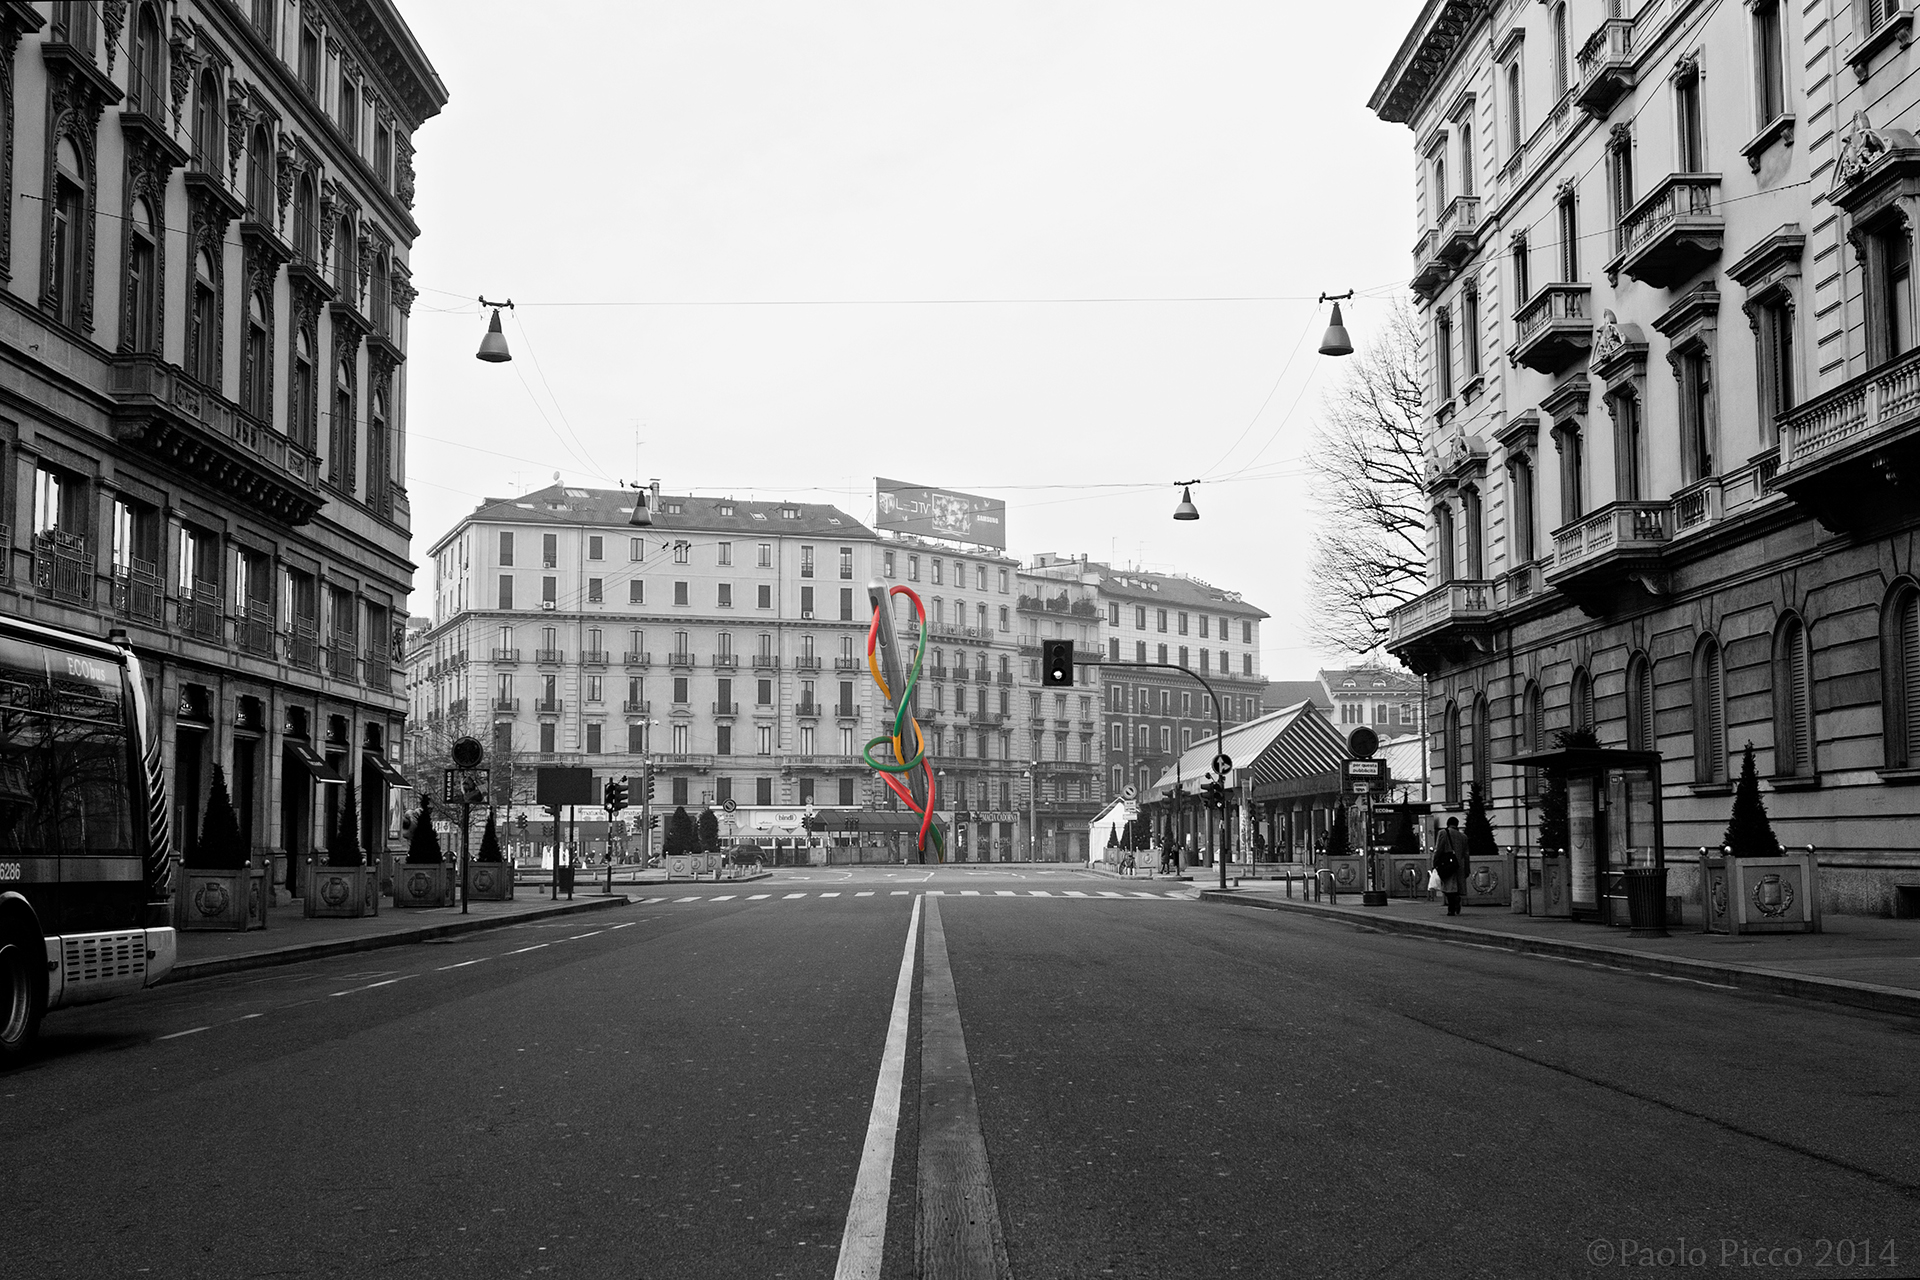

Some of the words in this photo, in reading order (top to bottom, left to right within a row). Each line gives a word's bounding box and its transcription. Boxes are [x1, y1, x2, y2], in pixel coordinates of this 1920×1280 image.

[977, 515, 999, 524] SAMSUNG
[66, 657, 106, 682] ECObus
[0, 862, 21, 880] 6286
